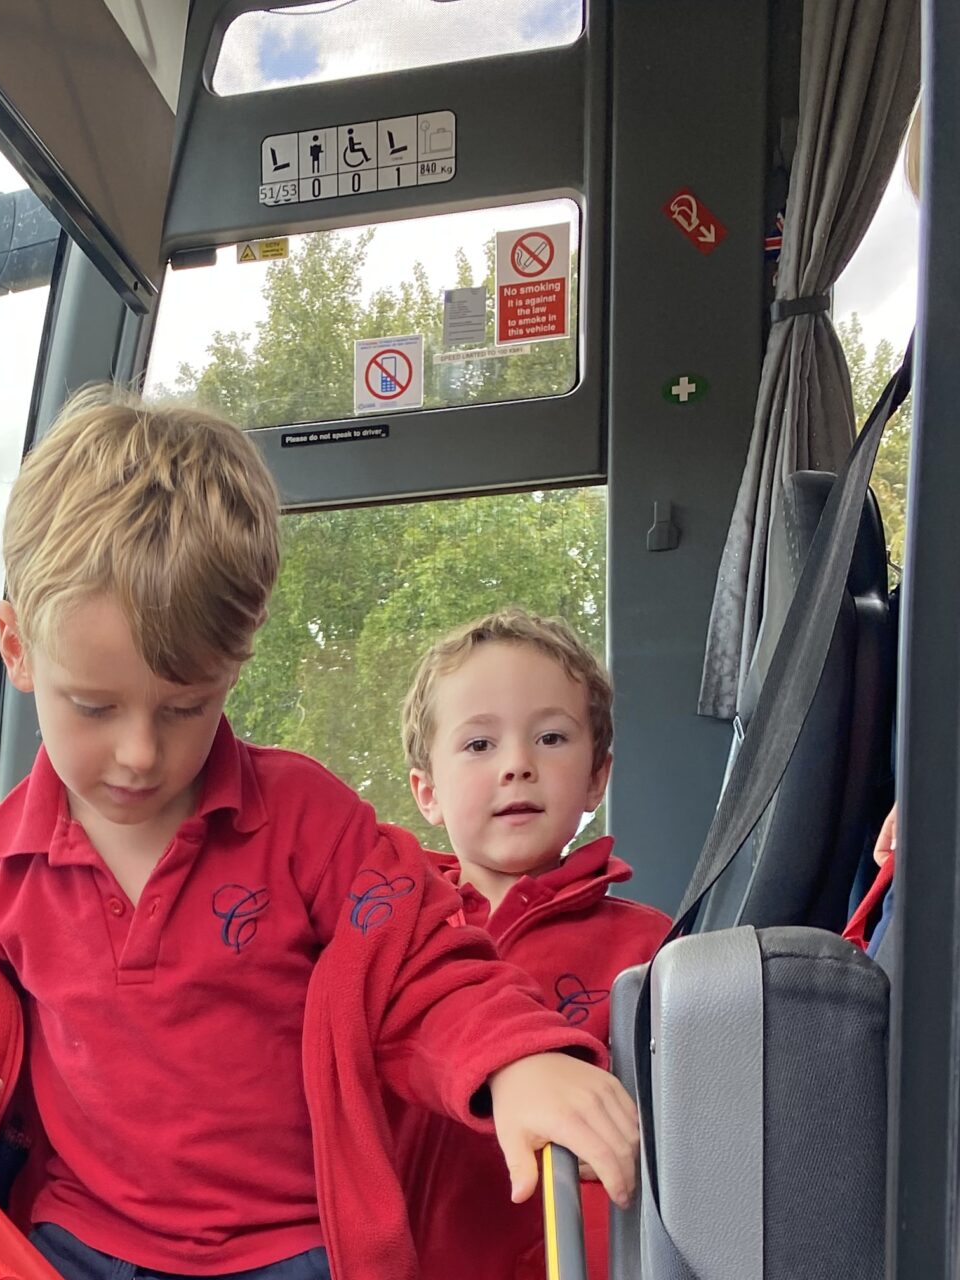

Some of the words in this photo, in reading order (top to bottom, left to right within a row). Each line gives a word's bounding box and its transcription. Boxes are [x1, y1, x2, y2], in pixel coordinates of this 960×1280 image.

[419, 162, 437, 175] 840
[440, 165, 453, 175] Kg
[351, 173, 361, 192] 0
[394, 167, 401, 187] 1
[259, 183, 297, 200] 51/53
[311, 178, 321, 198] 0
[503, 287, 518, 297] No
[519, 282, 561, 295] smoking
[525, 294, 556, 306] against
[517, 308, 531, 316] the
[532, 306, 547, 314] law
[507, 319, 517, 327] to
[518, 316, 547, 326] smoke
[508, 328, 524, 337] this
[525, 324, 556, 334] vehicle
[285, 436, 308, 444] Please
[332, 431, 352, 440] speak
[362, 428, 382, 436] driver
